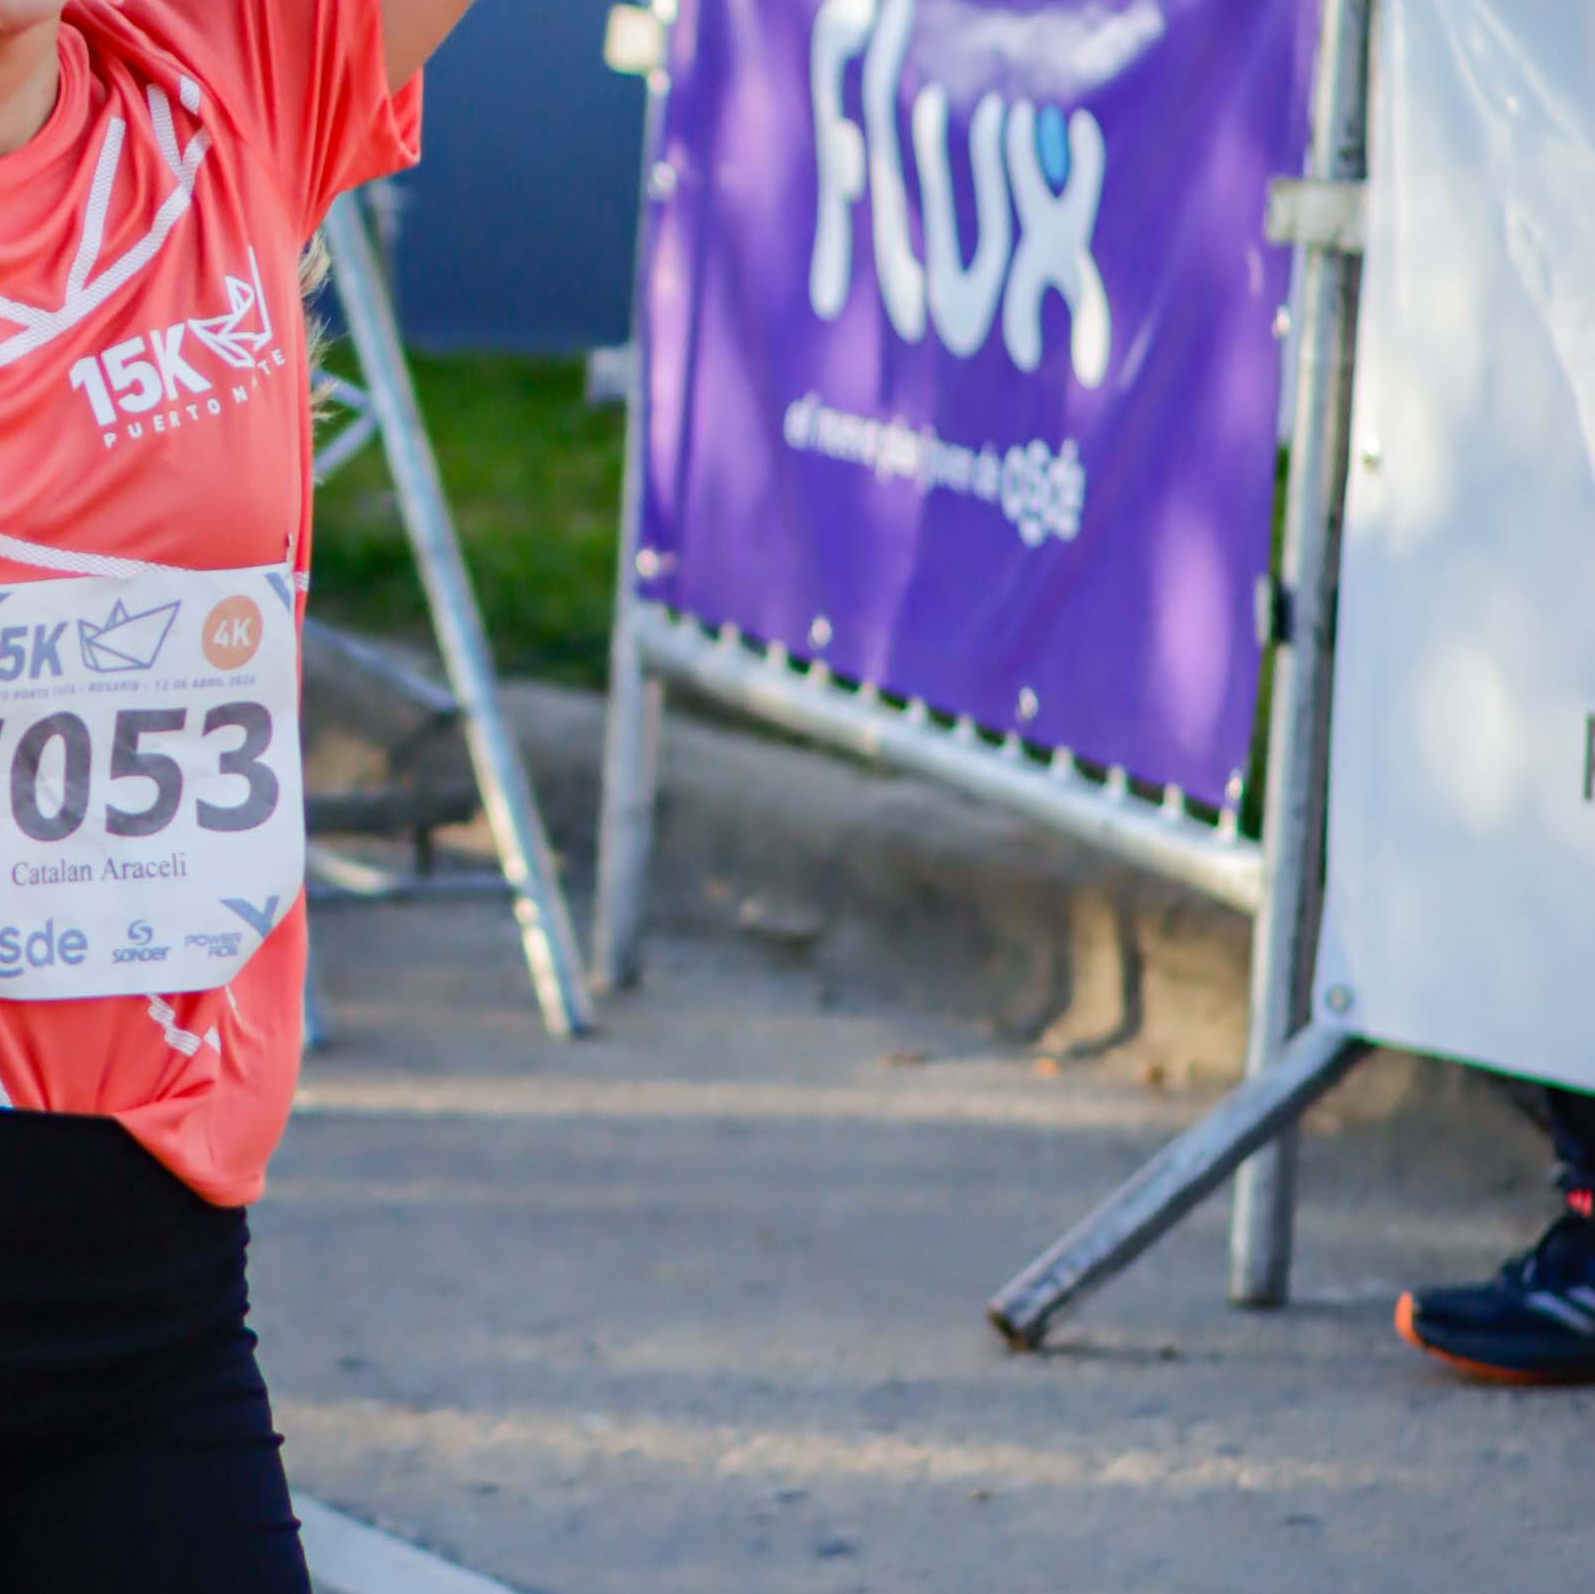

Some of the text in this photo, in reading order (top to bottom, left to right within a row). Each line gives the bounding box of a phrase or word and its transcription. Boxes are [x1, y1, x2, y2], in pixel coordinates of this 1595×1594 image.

[69, 322, 213, 426] 15K
[103, 348, 286, 449] PUERTO NTE
[213, 616, 252, 649] 4K
[11, 852, 188, 886] Catalan Araceli
[184, 932, 243, 947] POWER
